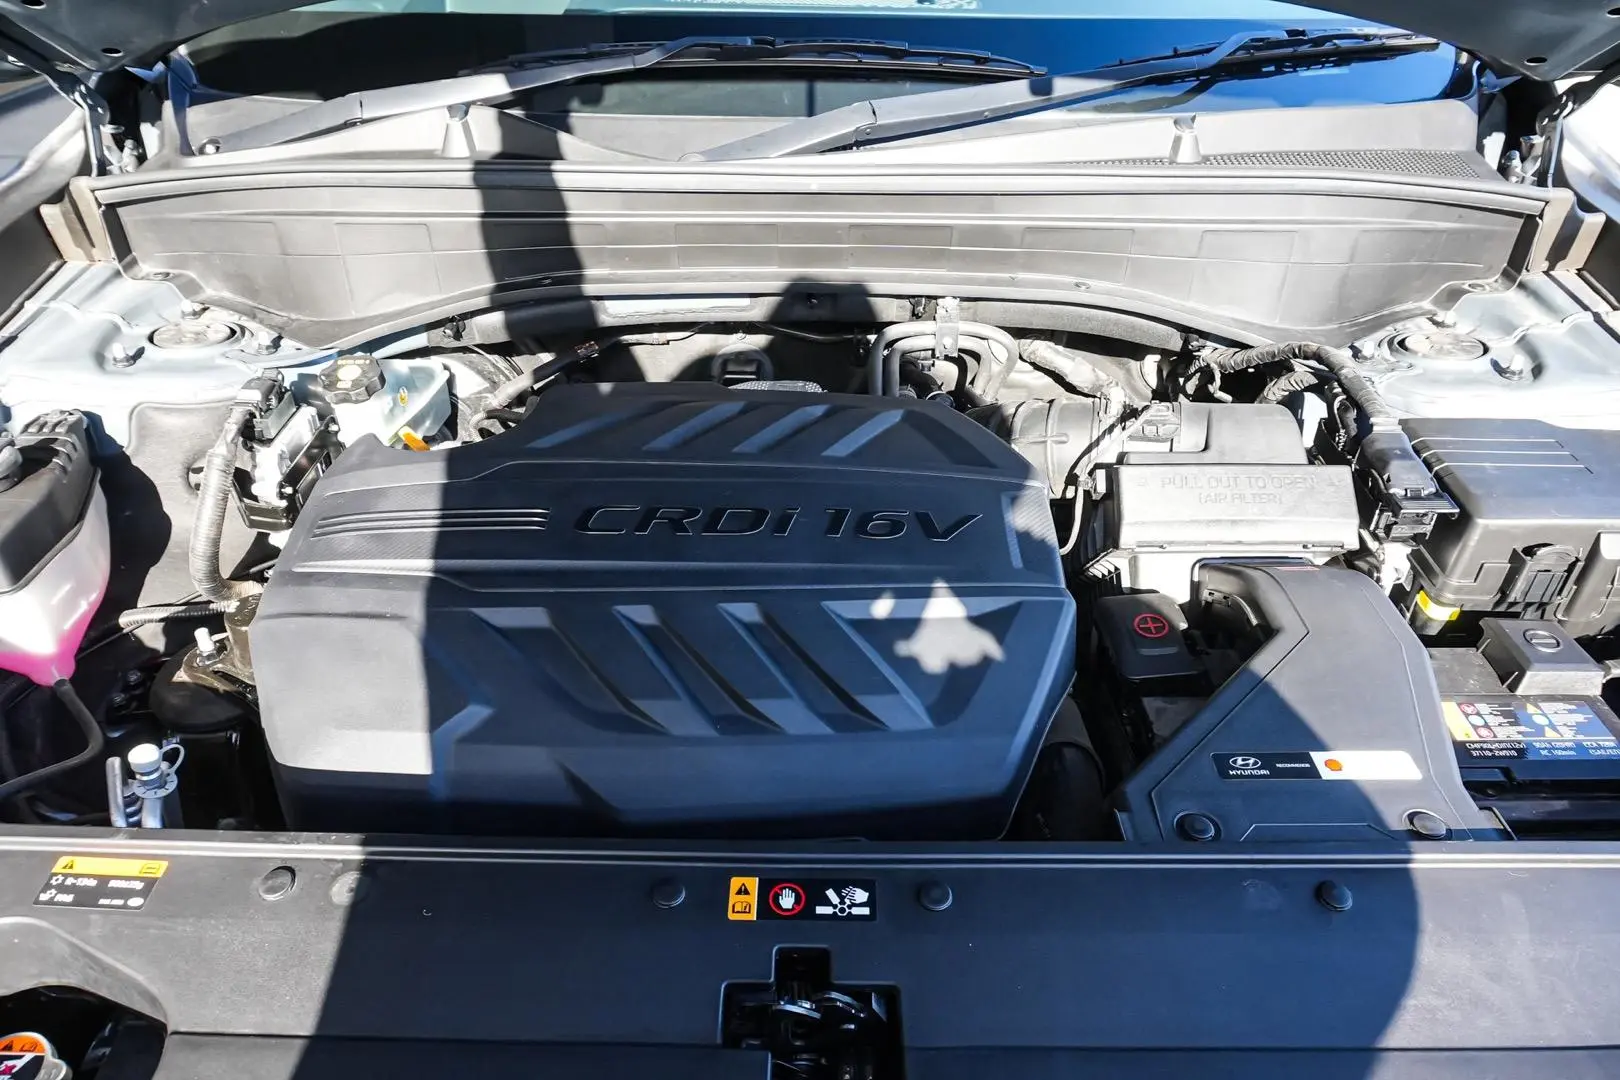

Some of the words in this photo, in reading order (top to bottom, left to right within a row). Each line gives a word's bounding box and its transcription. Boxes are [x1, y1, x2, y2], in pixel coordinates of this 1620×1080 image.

[1160, 475, 1203, 489] PULL
[1207, 475, 1241, 488] OUT
[1244, 475, 1267, 488] TO
[1270, 475, 1317, 489] OPEN
[573, 505, 800, 537] CRDi
[824, 507, 984, 541] 16V
